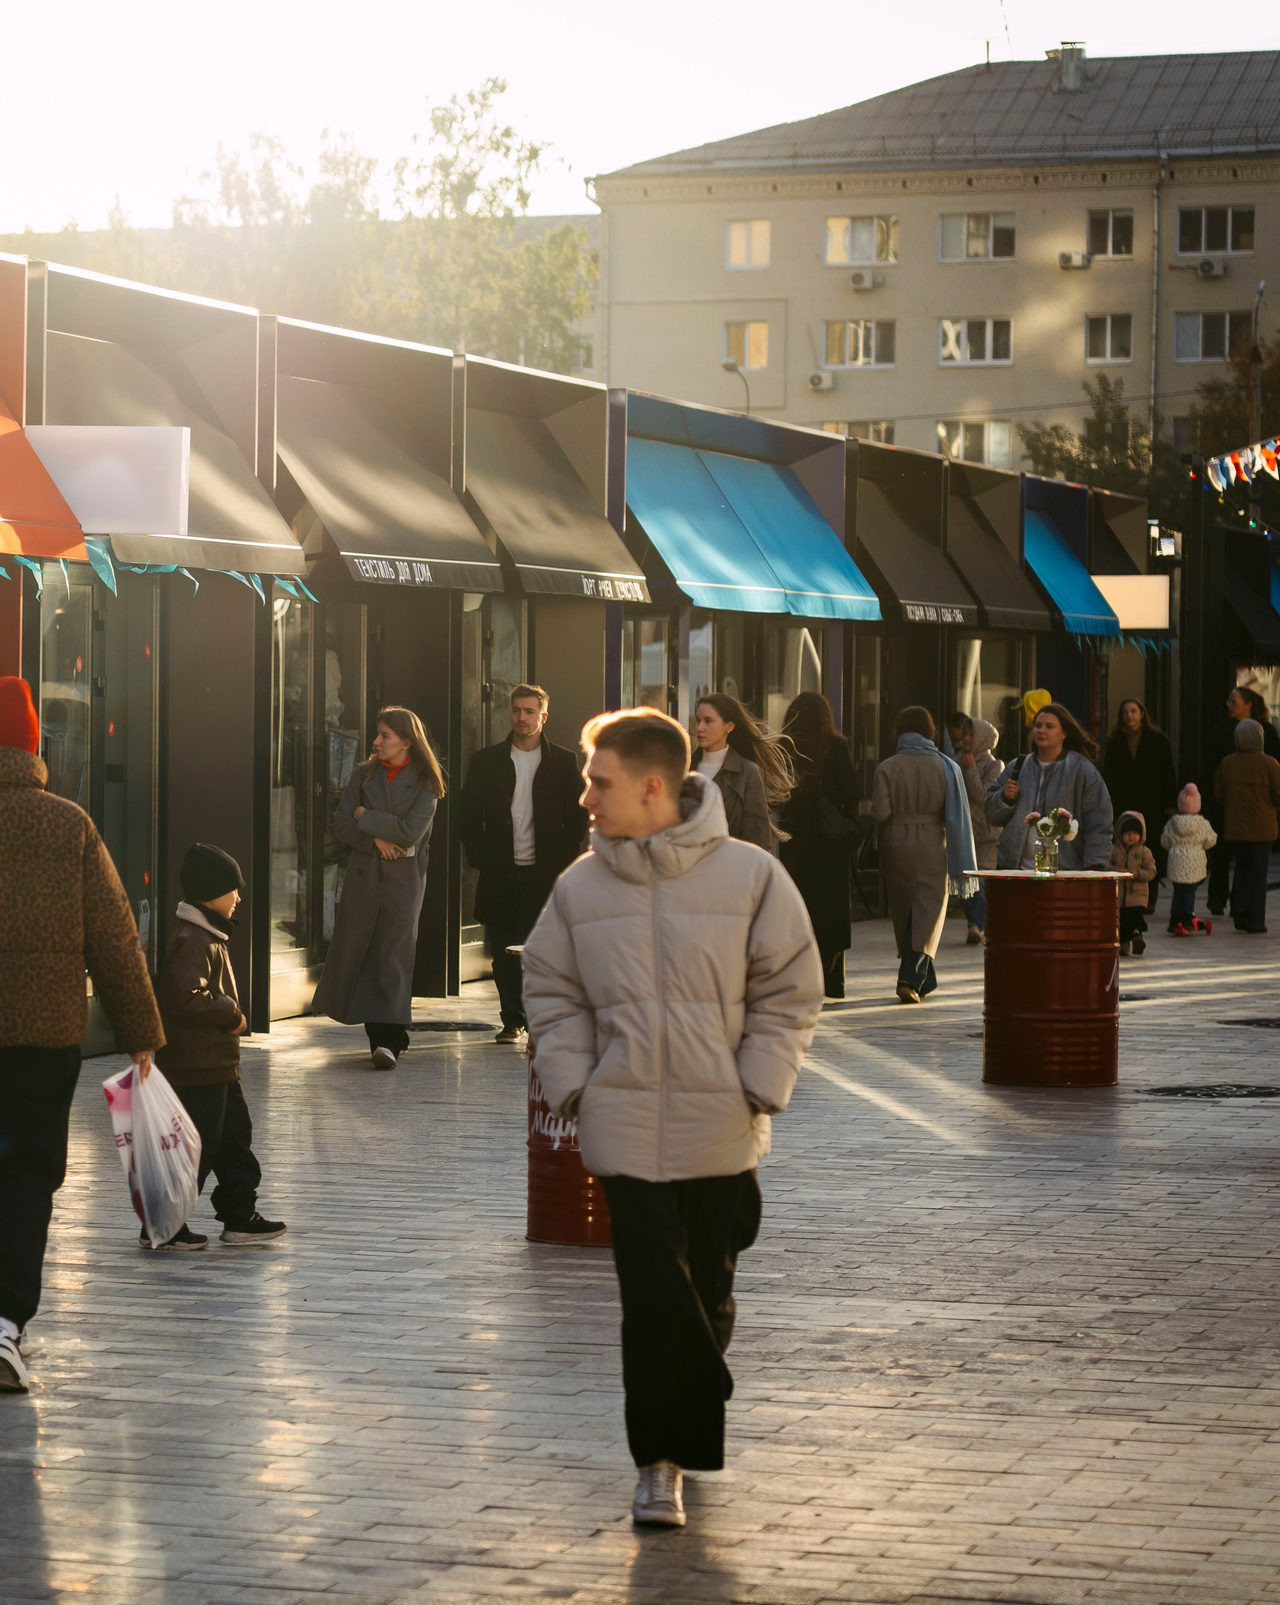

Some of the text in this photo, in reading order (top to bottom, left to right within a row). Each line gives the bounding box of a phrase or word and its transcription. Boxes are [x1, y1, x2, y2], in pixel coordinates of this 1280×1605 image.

[354, 559, 433, 584] ТЕКСТИЛЬ ДЛЯ ДОМА
